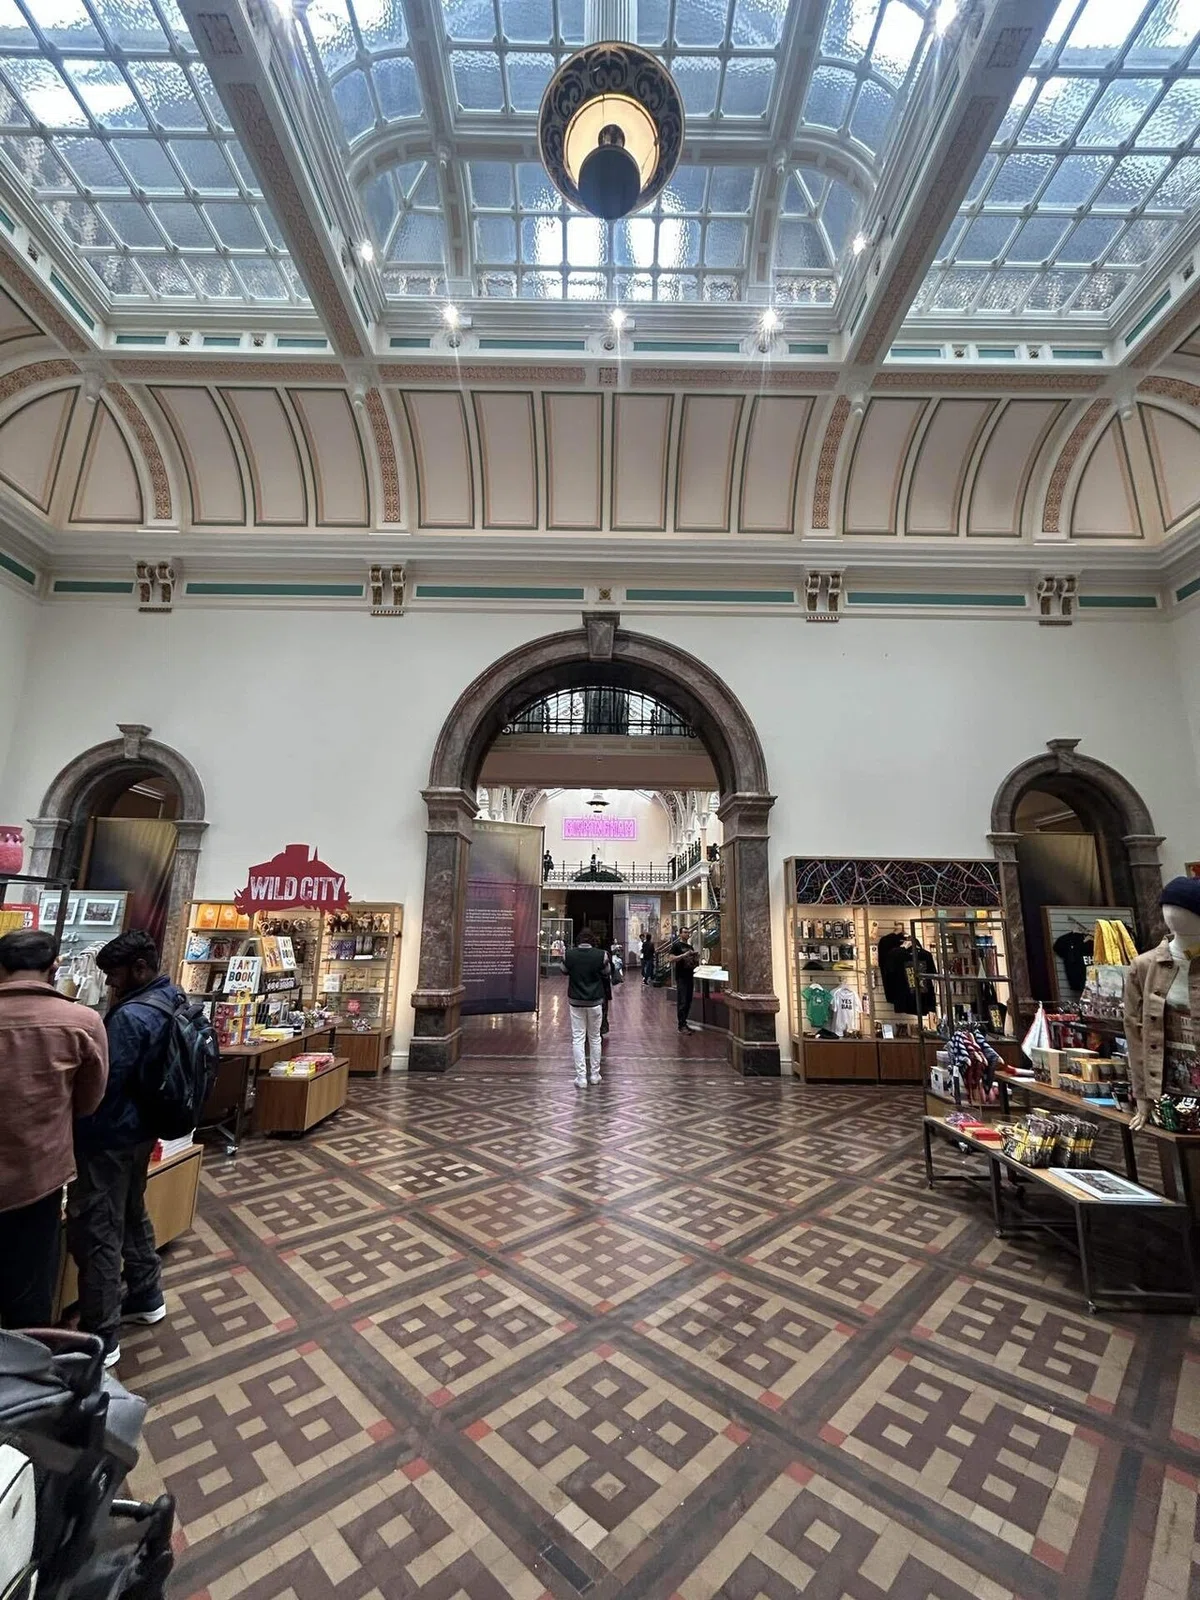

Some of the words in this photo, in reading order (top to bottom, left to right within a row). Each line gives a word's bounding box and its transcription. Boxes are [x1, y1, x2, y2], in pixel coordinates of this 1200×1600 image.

[565, 820, 634, 837] BIRMINGHAM
[250, 876, 298, 901] WILD
[299, 876, 344, 901] CITY
[237, 960, 257, 970] ART
[228, 971, 255, 982] BOOK
